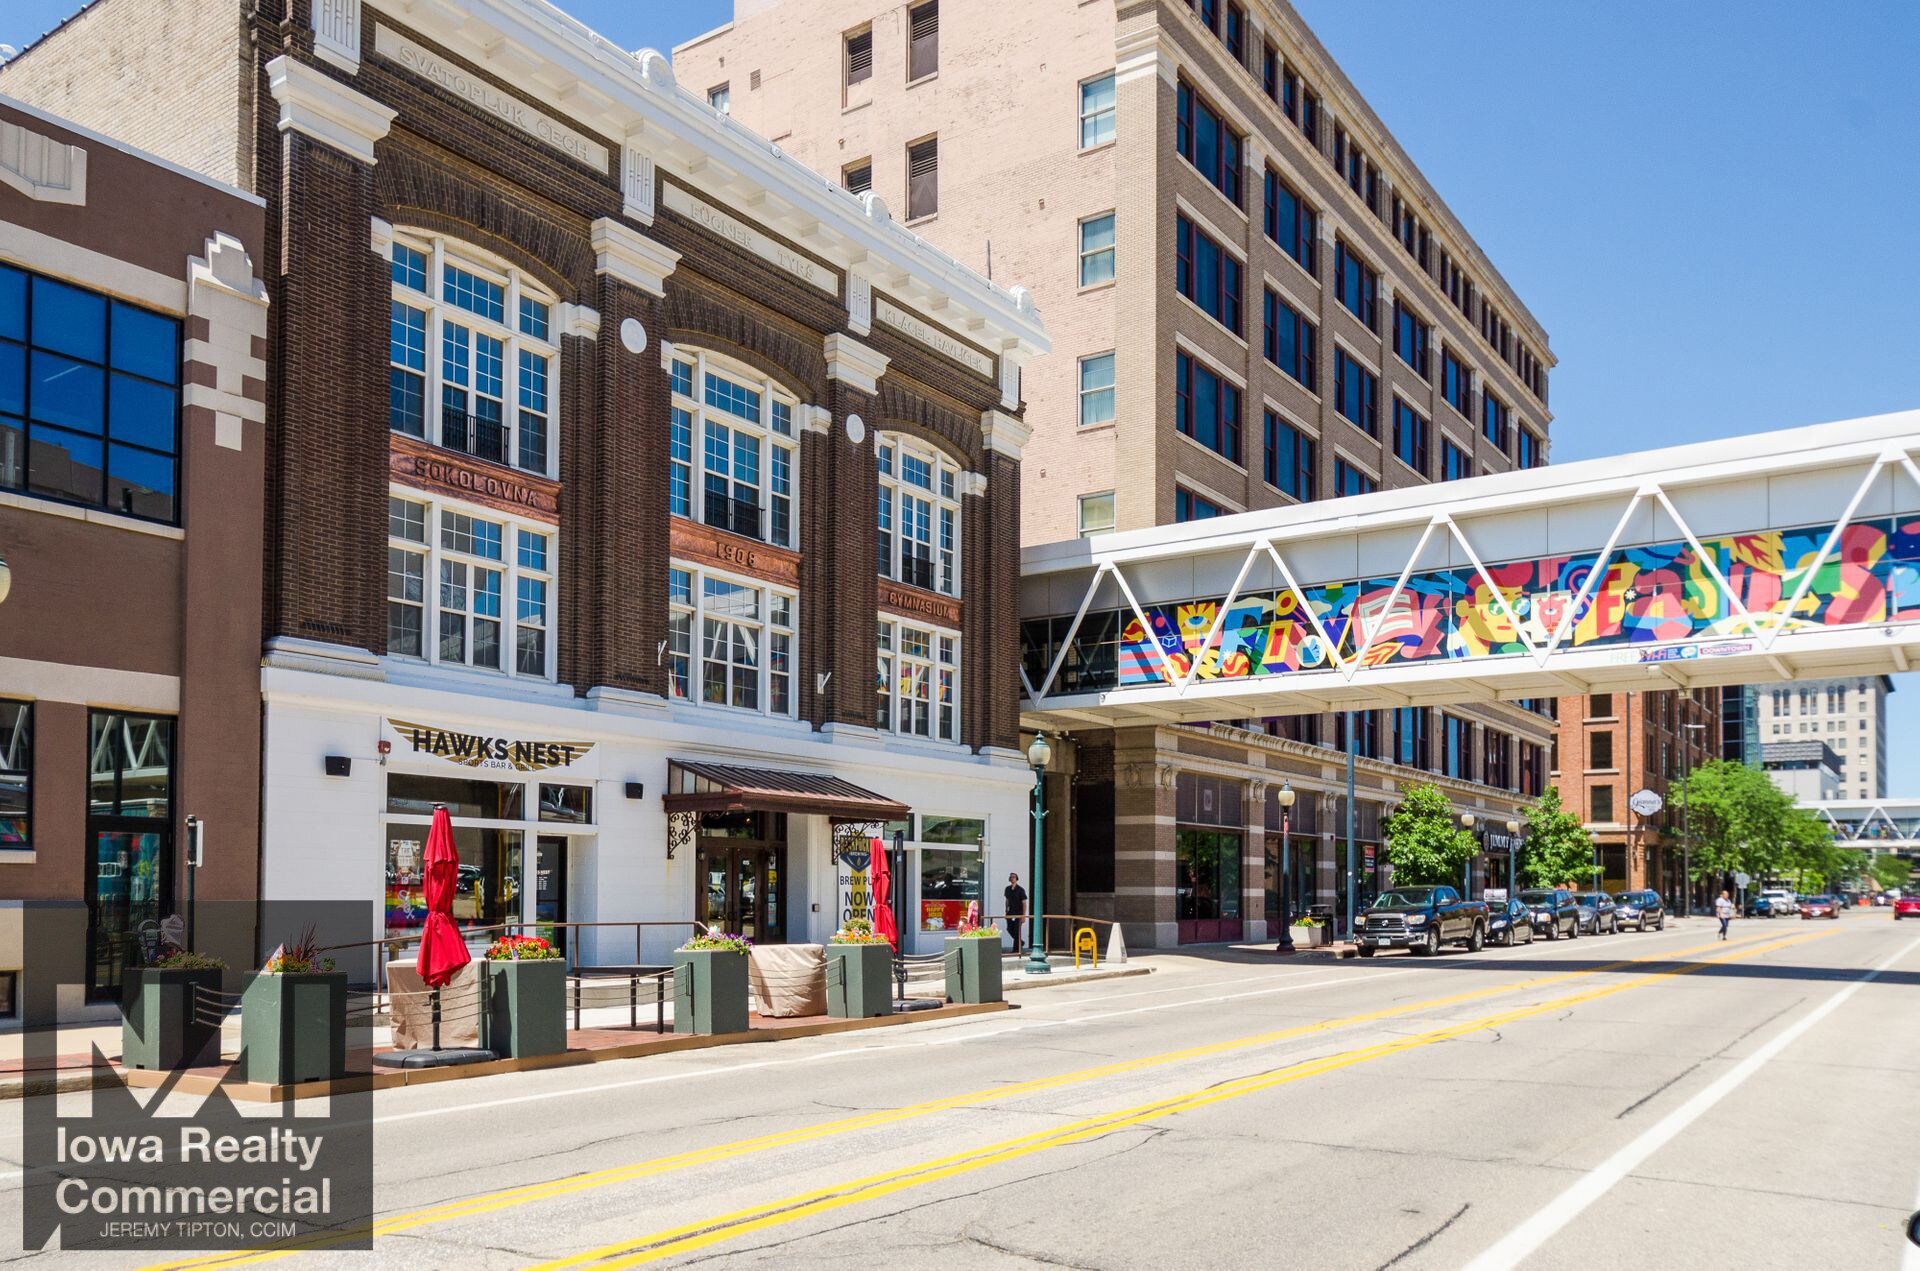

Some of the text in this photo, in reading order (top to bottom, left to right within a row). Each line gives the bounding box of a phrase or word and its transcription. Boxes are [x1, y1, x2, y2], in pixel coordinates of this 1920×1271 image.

[399, 45, 527, 128] SVATOPLUK
[414, 457, 539, 506] SOKOLOVNA
[716, 541, 756, 567] 1908
[888, 591, 955, 619] GYMNASIUM
[413, 729, 575, 767] HAWKS NEST
[490, 760, 506, 769] BAR
[840, 875, 861, 886] BREW
[845, 892, 874, 907] NOW
[843, 908, 875, 923] OPEN
